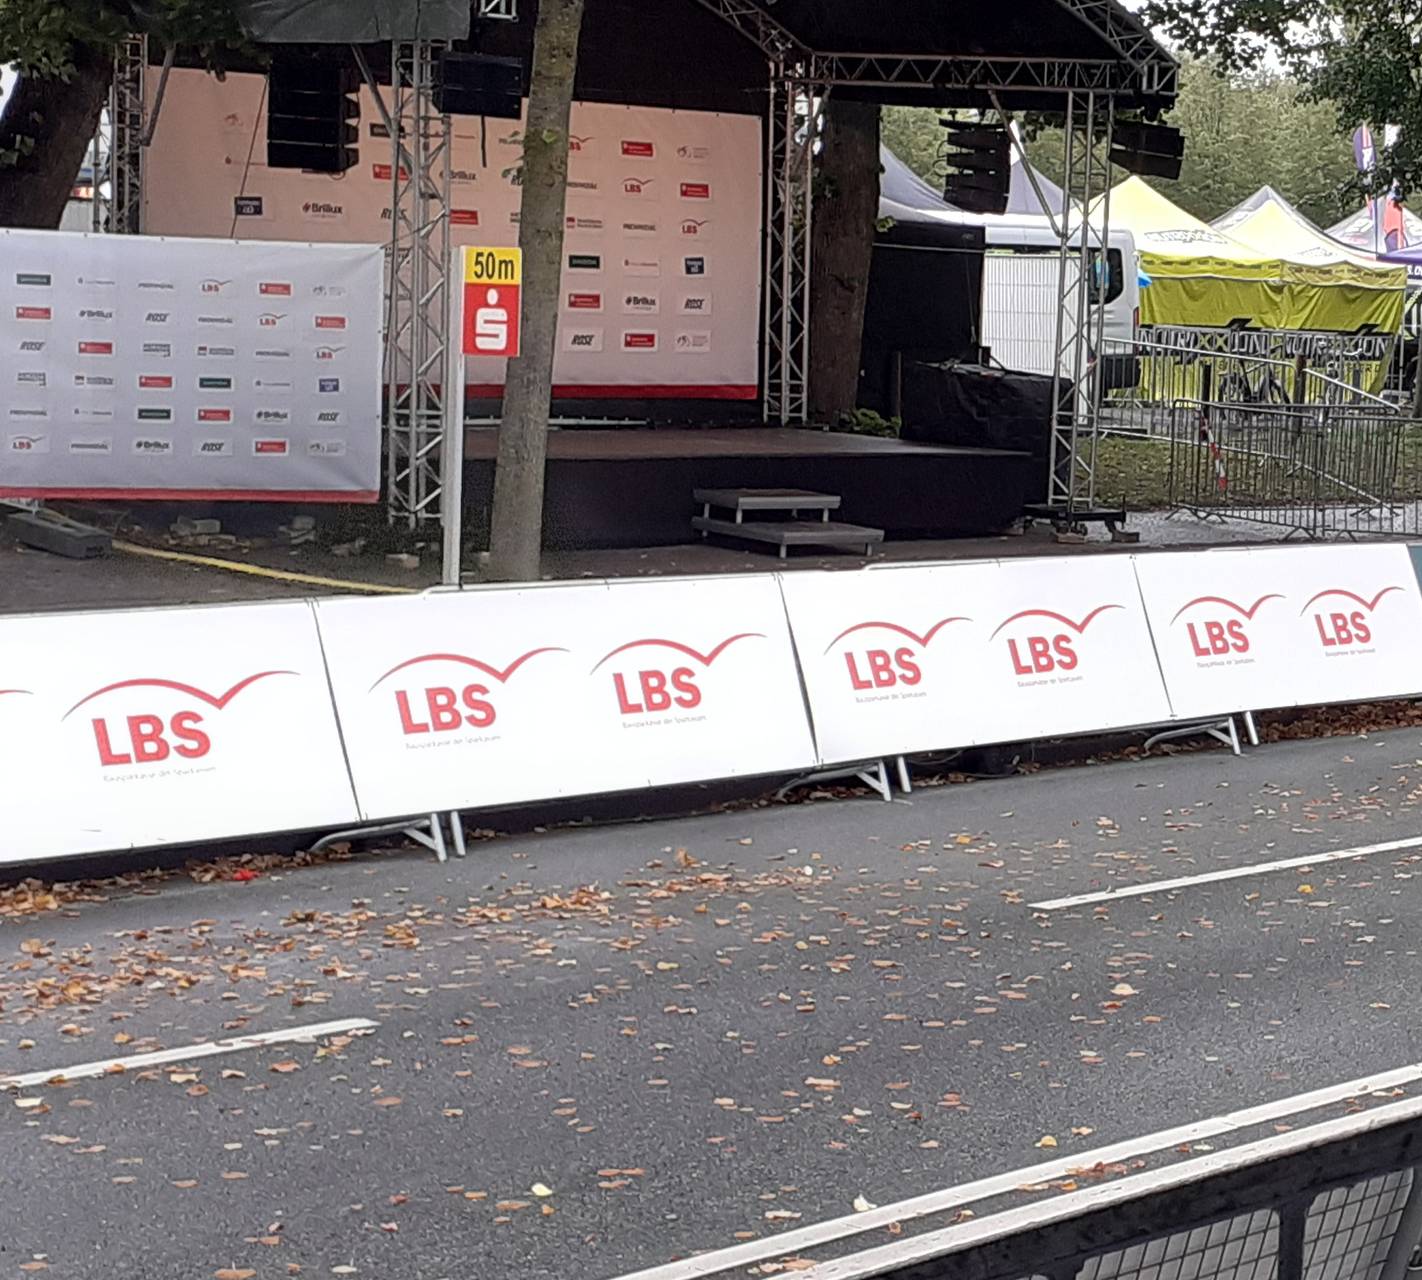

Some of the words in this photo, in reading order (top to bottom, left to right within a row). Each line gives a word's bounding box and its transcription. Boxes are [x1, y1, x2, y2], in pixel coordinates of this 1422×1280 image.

[1187, 618, 1251, 658] LBS
[1315, 610, 1373, 648] LBS
[844, 647, 923, 690] LBS
[1008, 634, 1079, 675] LBS
[395, 683, 498, 736] LBS
[613, 666, 703, 716] LBS
[91, 710, 213, 768] LBS
